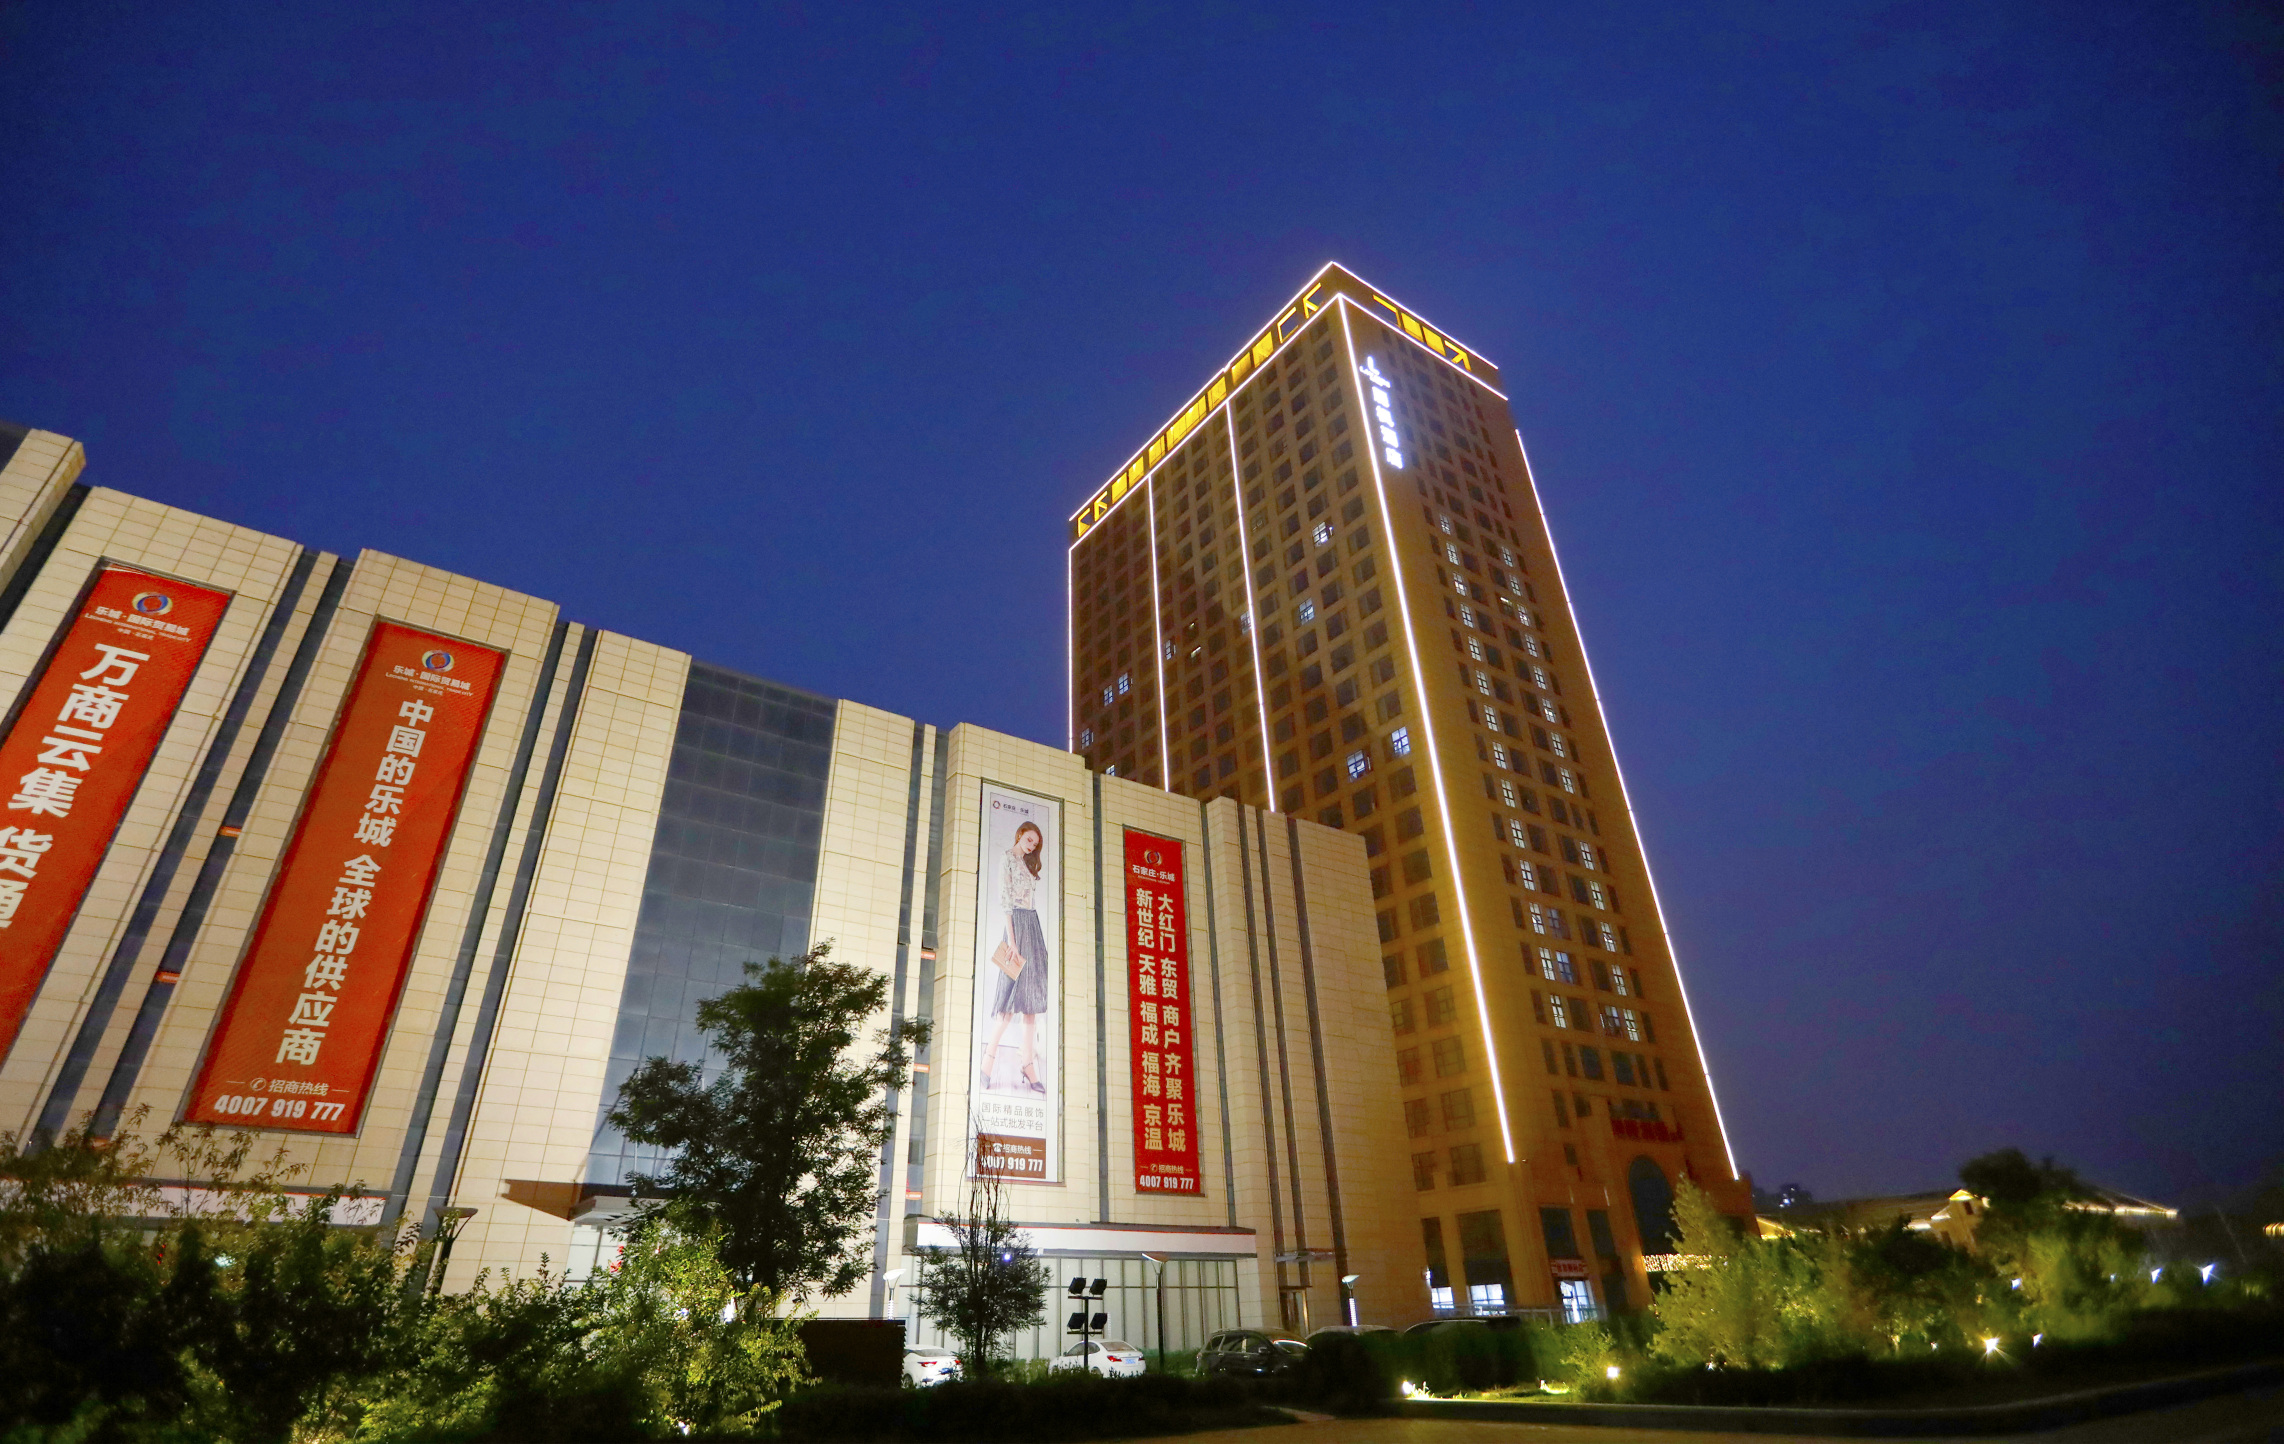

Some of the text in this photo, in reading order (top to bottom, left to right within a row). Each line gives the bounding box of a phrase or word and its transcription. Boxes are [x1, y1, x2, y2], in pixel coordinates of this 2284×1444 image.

[393, 665, 471, 691] 乐城·国际贸易城
[8, 643, 150, 818] 万商云集
[275, 699, 434, 1065] 中国的乐城 全球的供应商
[1132, 864, 1176, 882] 石家庄·乐城
[1136, 888, 1155, 949] 新世纪
[1157, 893, 1176, 953] 大红门
[1138, 953, 1157, 996] 天雅
[1160, 957, 1178, 1000] 东贸
[1140, 1001, 1159, 1046] 福成
[268, 1079, 329, 1096] 招商热线
[1141, 1051, 1161, 1097] 福海
[214, 1094, 345, 1121] 4007 919 777
[981, 1102, 1044, 1118] 国际精品服饰
[982, 1116, 1043, 1131] 一站式批发平台
[1143, 1103, 1163, 1151] 京温
[1007, 1157, 1026, 1170] 919
[1028, 1159, 1043, 1172] 777
[1140, 1175, 1194, 1189] 4007 919 777
